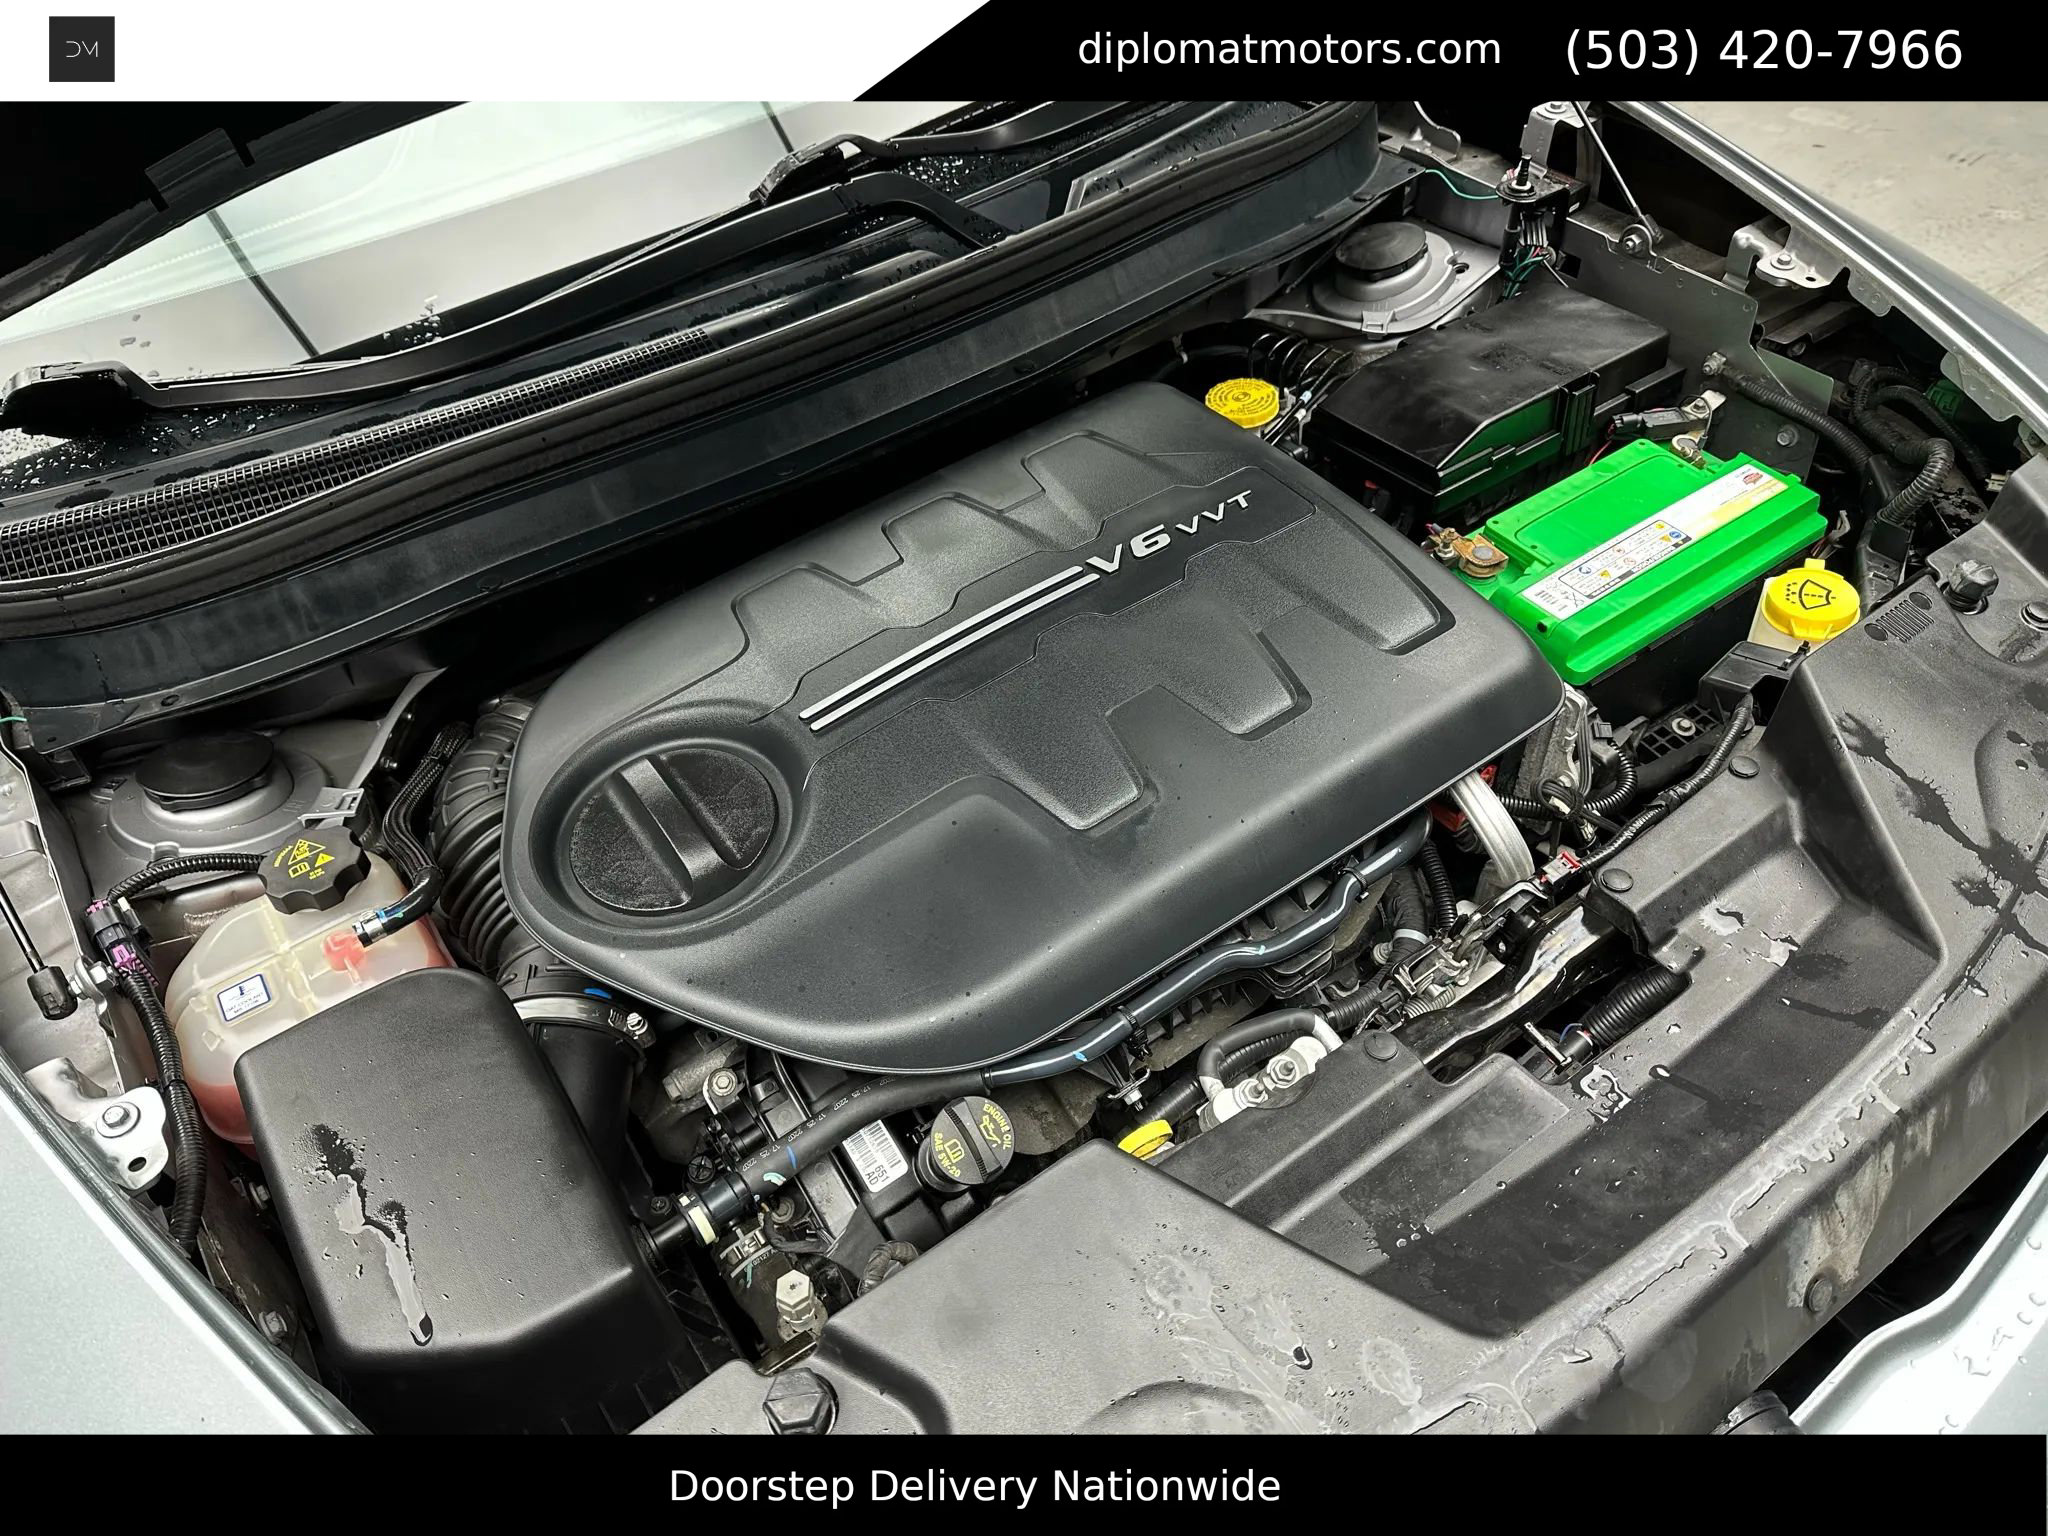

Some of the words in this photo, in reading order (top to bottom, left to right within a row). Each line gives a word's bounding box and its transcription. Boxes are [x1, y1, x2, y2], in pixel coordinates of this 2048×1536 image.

[1085, 523, 1171, 573] V6
[1175, 490, 1251, 534] VVT
[983, 1103, 1011, 1133] ENGINE
[1002, 1133, 1012, 1150] OIL
[934, 1132, 944, 1152] SAE
[875, 1164, 890, 1183] 651
[937, 1152, 961, 1178] 5W-20
[865, 1171, 879, 1186] AD
